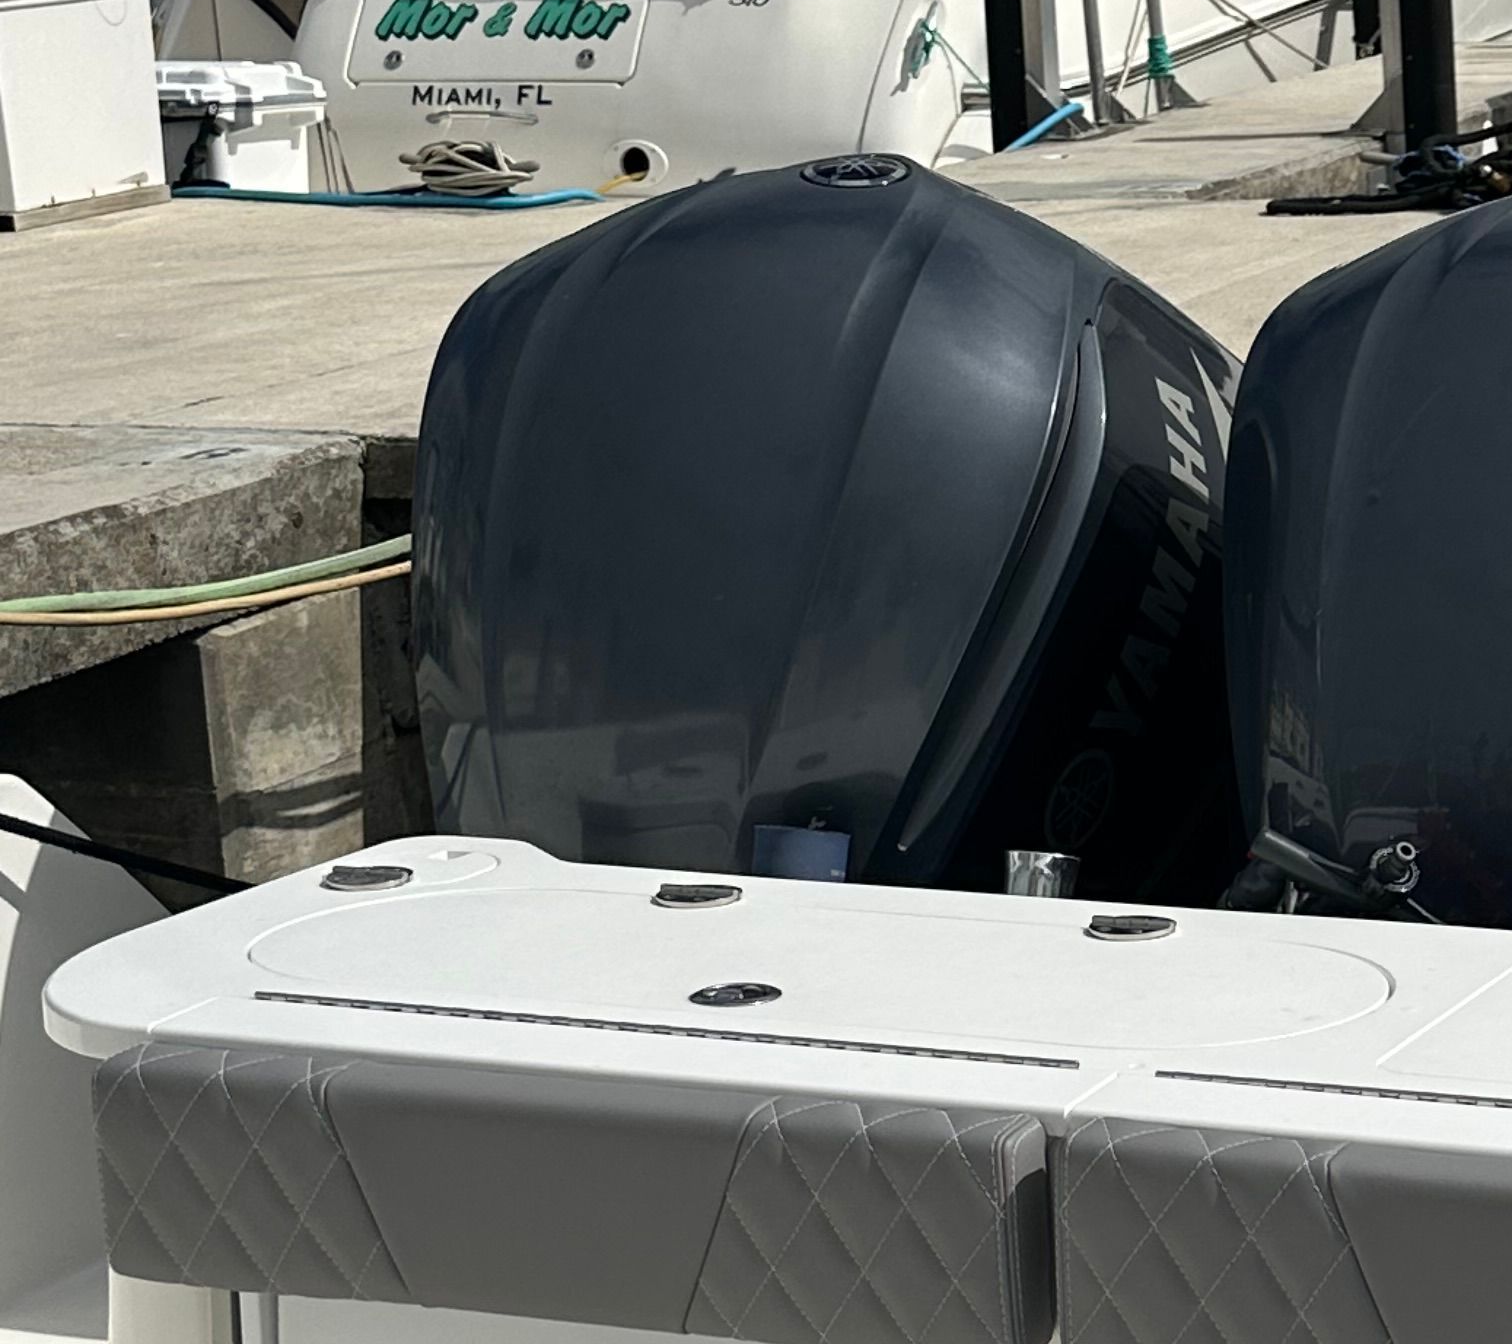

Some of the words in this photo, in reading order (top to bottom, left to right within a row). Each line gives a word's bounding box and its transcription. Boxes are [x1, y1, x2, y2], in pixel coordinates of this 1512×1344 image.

[483, 0, 518, 38] &
[411, 85, 502, 109] MIAMI,
[516, 84, 553, 105] FL
[1088, 376, 1210, 737] YAMAHA
